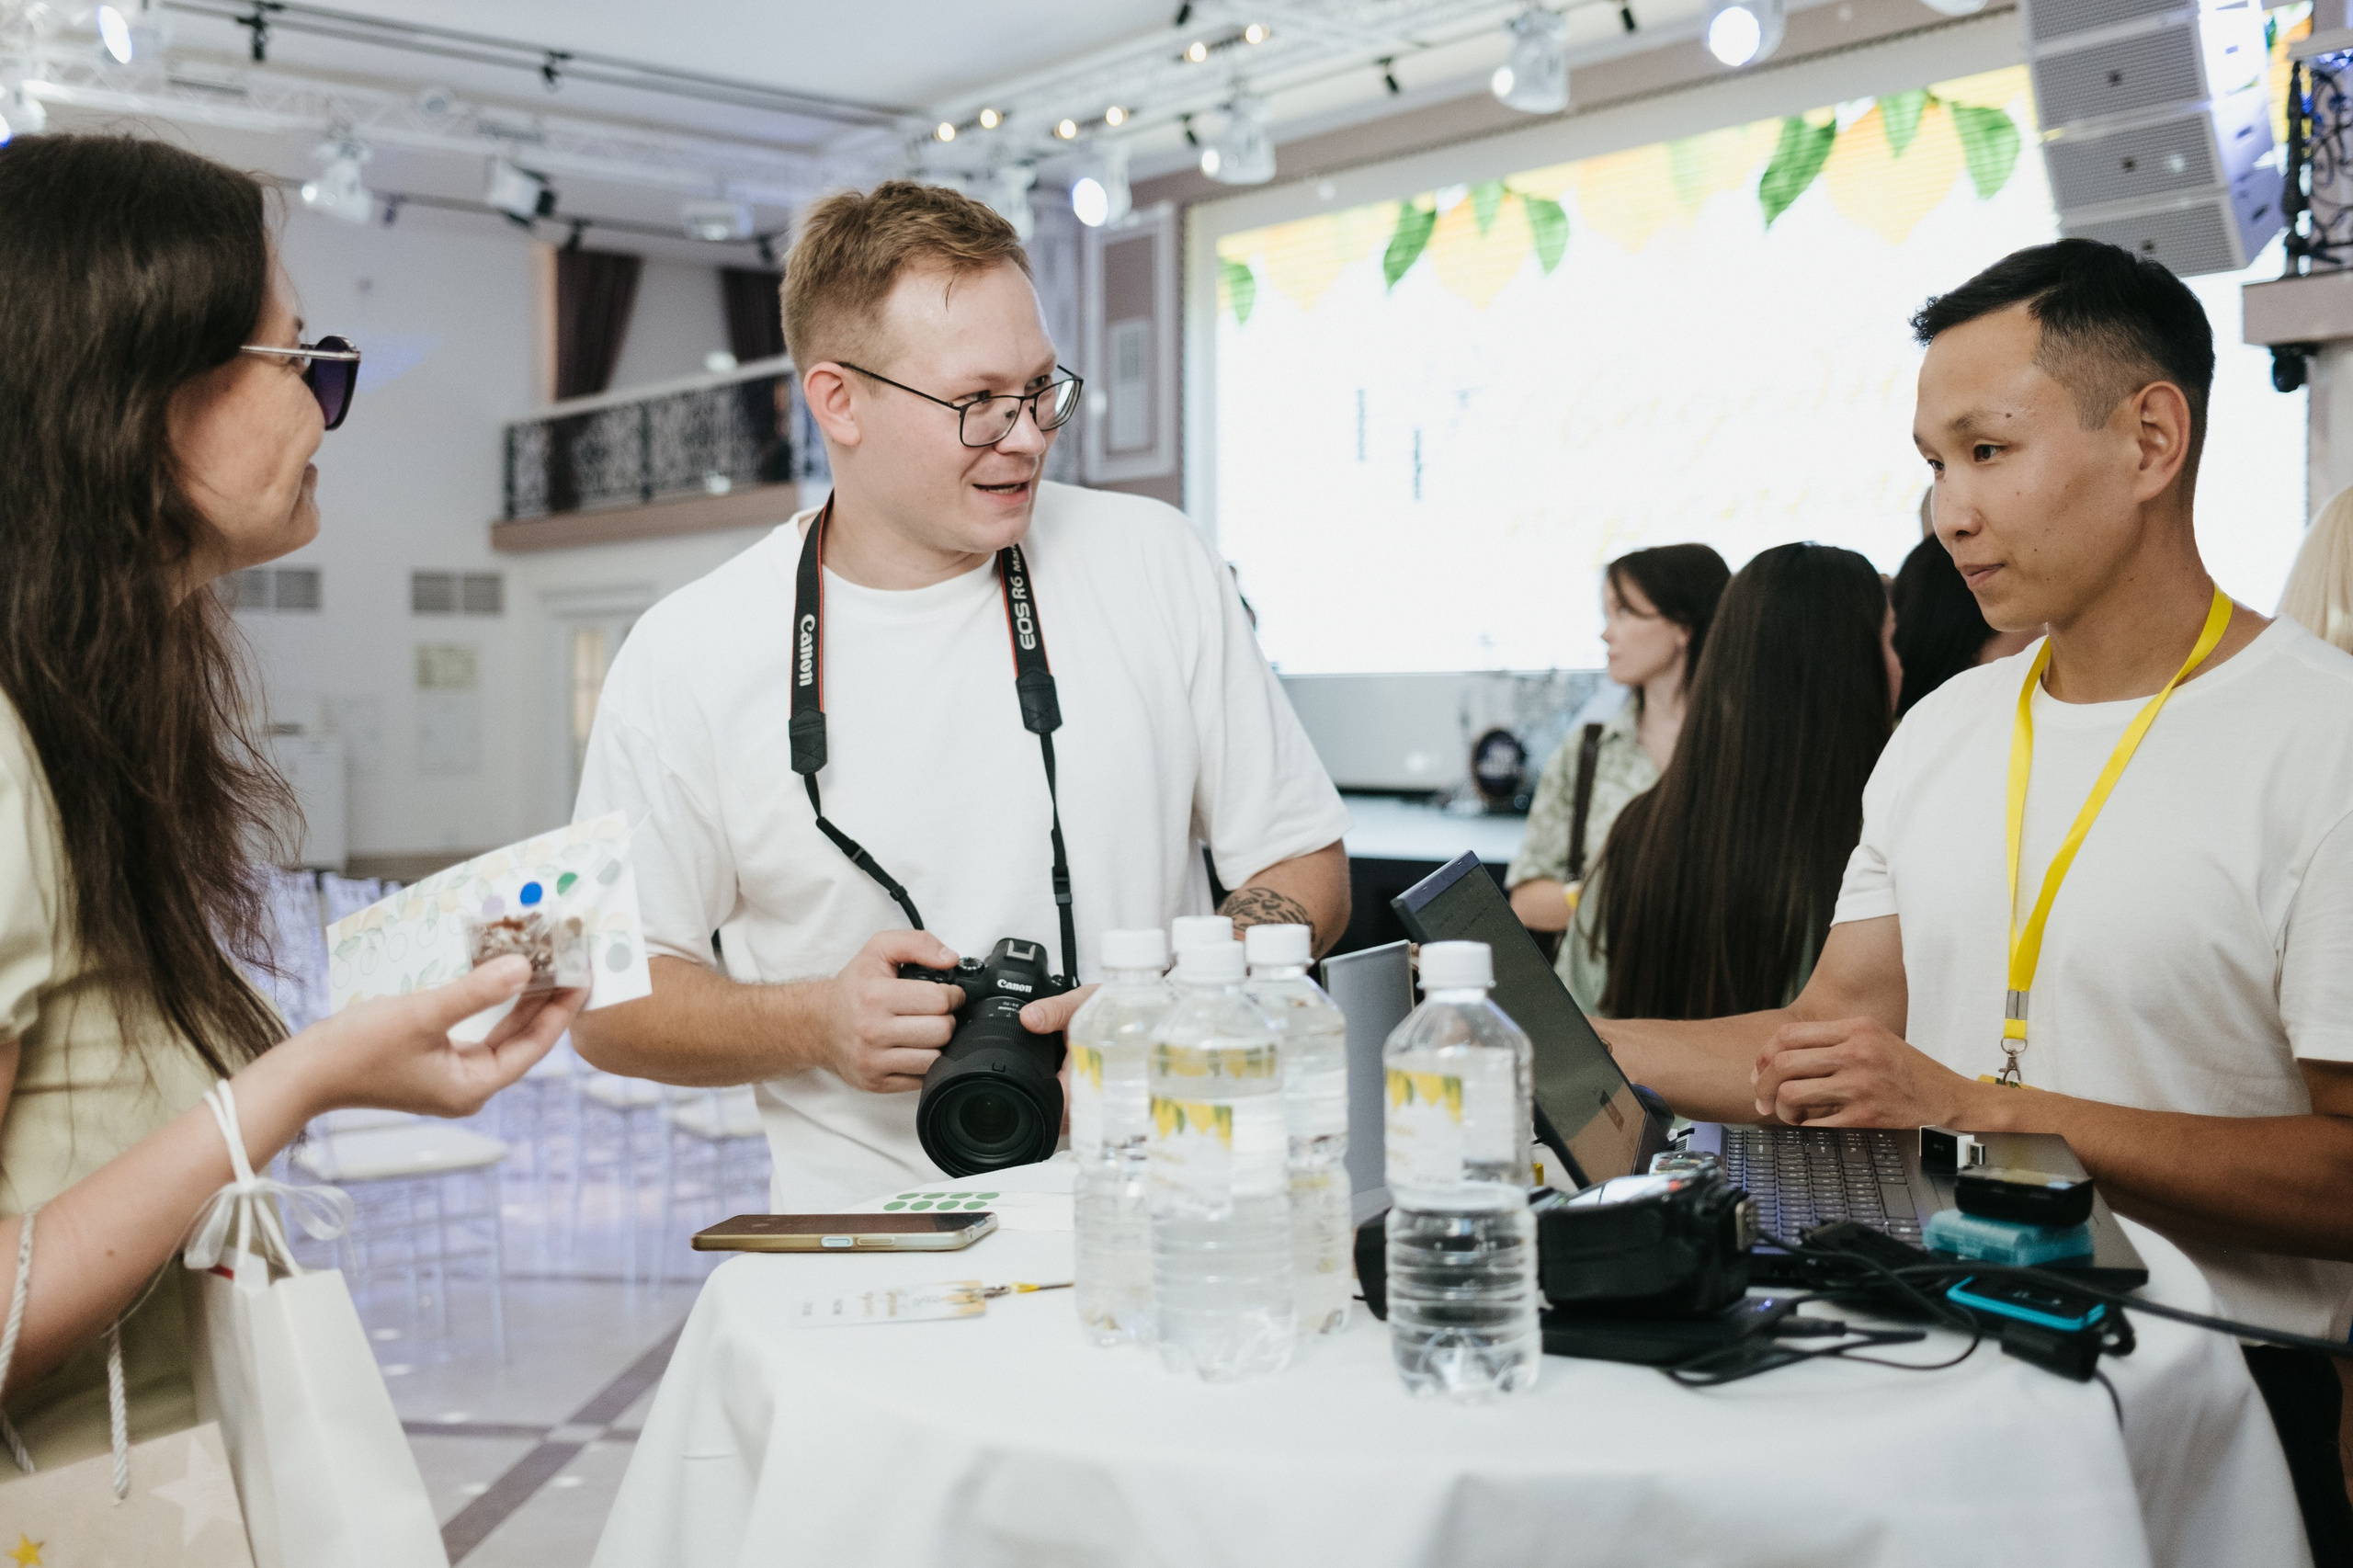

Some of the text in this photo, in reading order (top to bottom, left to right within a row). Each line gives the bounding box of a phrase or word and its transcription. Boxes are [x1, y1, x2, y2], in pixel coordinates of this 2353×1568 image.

[1010, 575, 1028, 600] R6
[1015, 602, 1037, 651] EOS
[799, 613, 816, 687] Canon
[996, 978, 1032, 993] Canon
